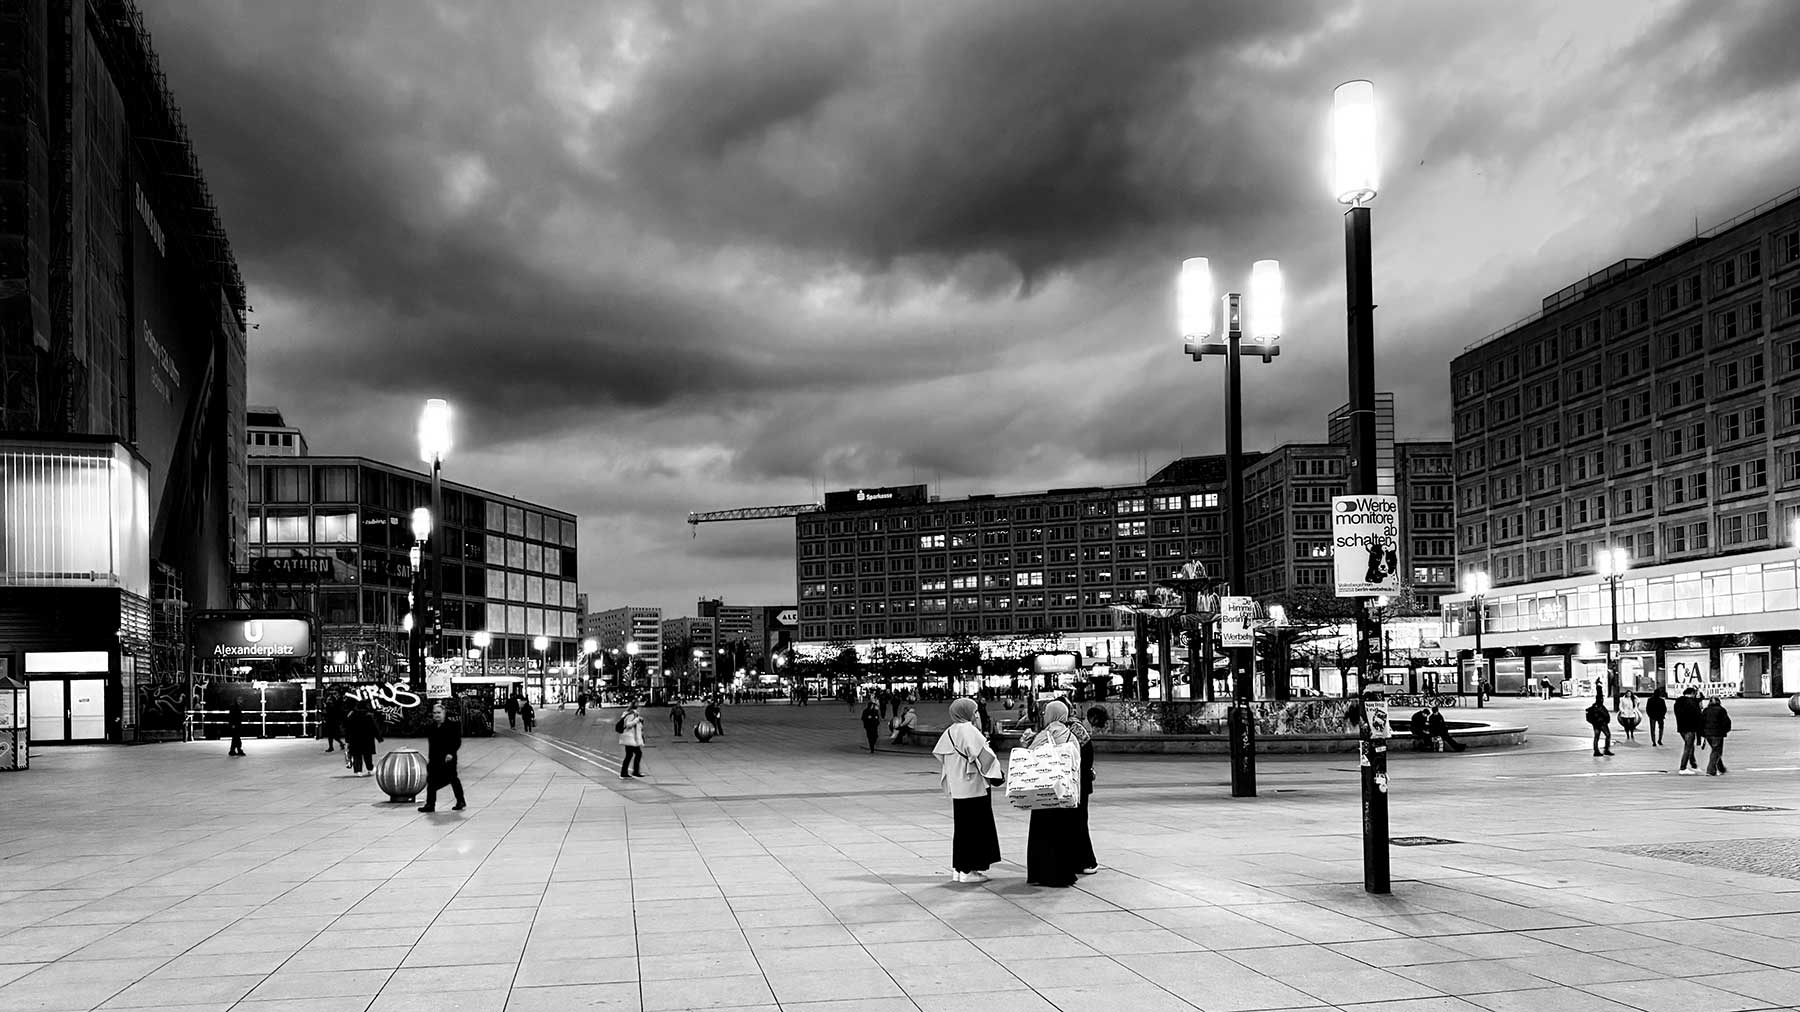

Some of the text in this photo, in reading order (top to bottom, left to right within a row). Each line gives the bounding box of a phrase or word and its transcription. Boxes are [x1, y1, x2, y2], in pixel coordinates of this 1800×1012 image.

[866, 492, 893, 501] Sparkasse
[1356, 498, 1396, 512] Werbe
[1336, 511, 1394, 524] monitore
[1384, 525, 1397, 536] ab
[1336, 533, 1392, 547] schalten
[244, 621, 264, 643] U
[214, 644, 294, 657] Alexanderplatz
[1674, 661, 1703, 684] C&A
